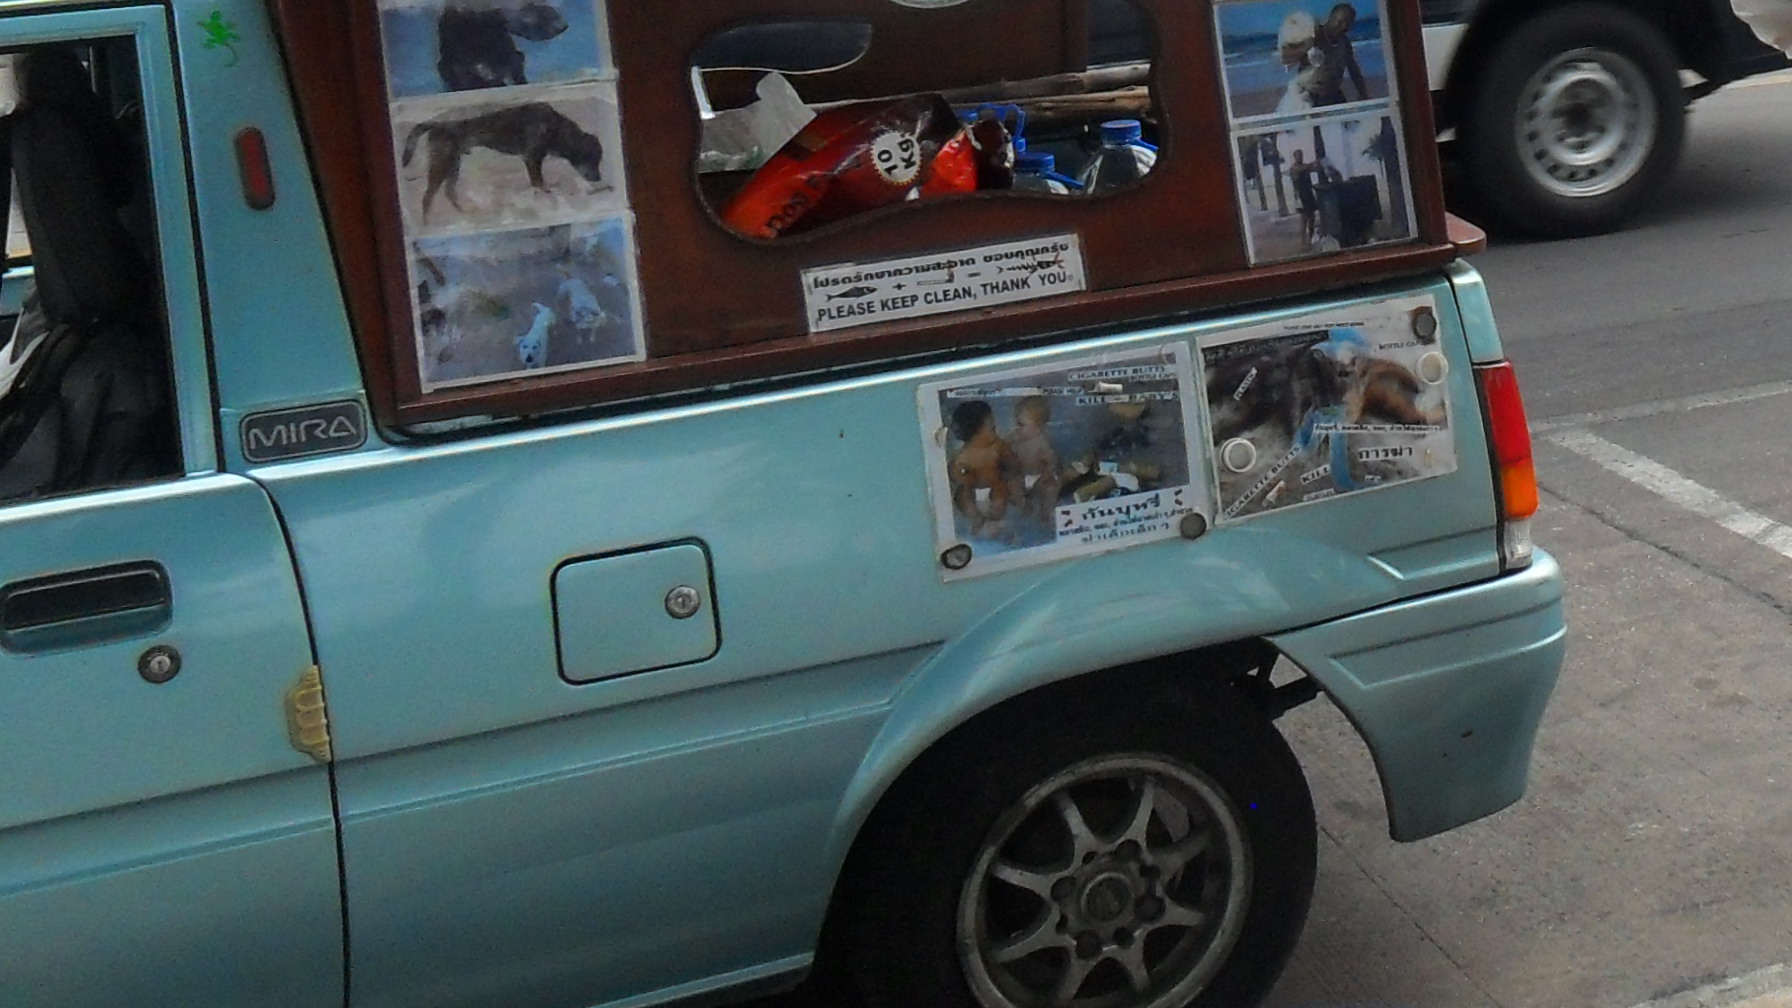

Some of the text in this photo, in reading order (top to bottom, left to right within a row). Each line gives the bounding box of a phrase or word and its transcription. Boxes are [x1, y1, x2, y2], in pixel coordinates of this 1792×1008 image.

[818, 300, 876, 322] PLEASE
[880, 294, 919, 312] KEEP
[923, 286, 977, 305] CLEAN,
[981, 277, 1031, 296] THANK
[248, 416, 356, 450] MIRA
